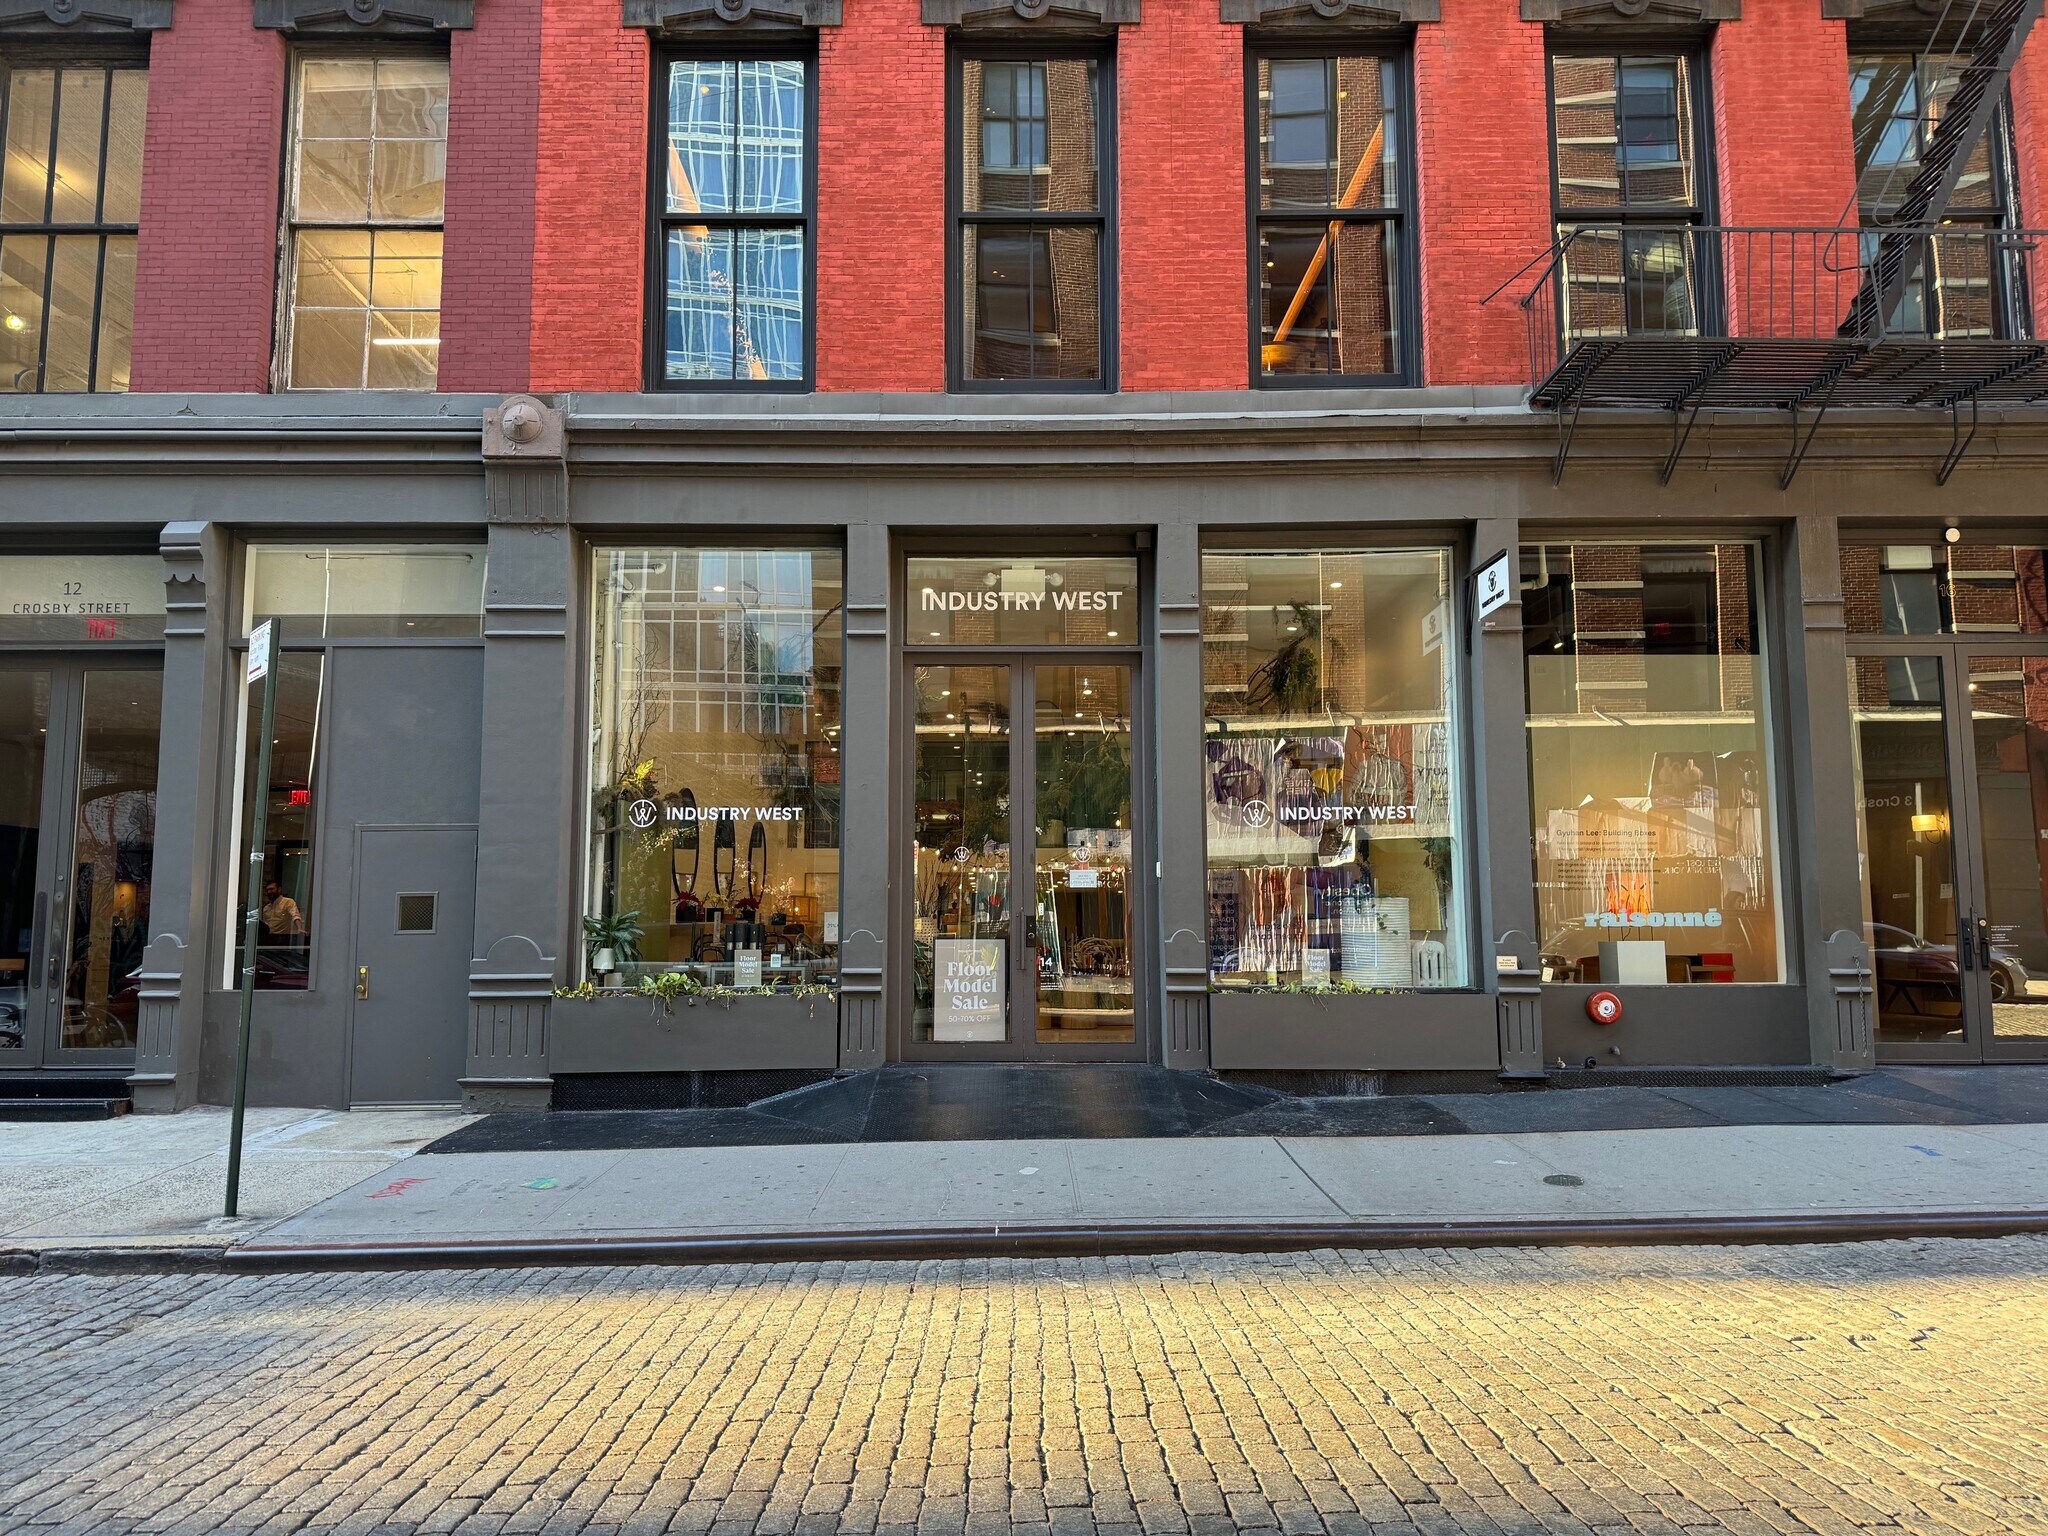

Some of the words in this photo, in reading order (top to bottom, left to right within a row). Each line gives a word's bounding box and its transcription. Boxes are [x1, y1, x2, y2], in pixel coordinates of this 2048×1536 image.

[63, 582, 82, 596] 12
[13, 603, 71, 614] CROSBY
[78, 602, 131, 614] STREET
[921, 591, 1046, 611] INDUSTRY
[1051, 591, 1123, 611] WEST
[666, 807, 751, 821] INDUSTRY
[755, 807, 803, 821] WEST
[1280, 806, 1364, 821] INDUSTRY
[1370, 806, 1418, 820] WEST
[1584, 908, 1723, 927] raisonné
[947, 961, 992, 977] Floor
[1039, 957, 1053, 967] 14
[943, 978, 997, 993] Model
[951, 994, 988, 1011] Sale
[948, 1015, 975, 1023] 50-70%
[976, 1014, 991, 1022] OFF
